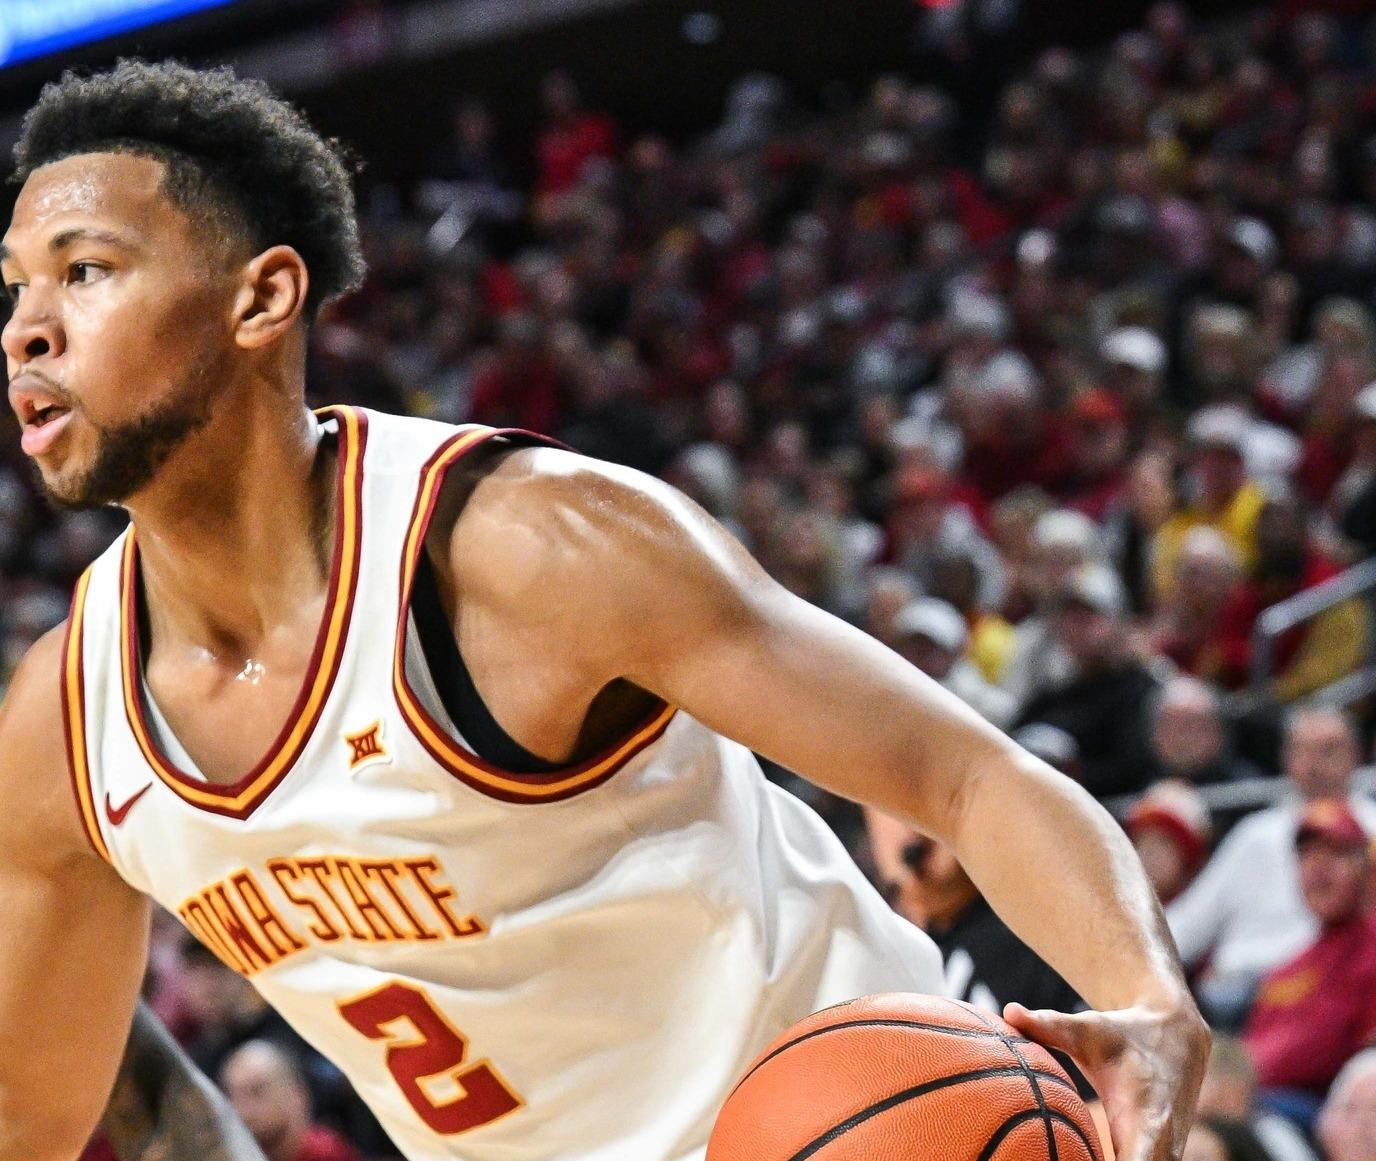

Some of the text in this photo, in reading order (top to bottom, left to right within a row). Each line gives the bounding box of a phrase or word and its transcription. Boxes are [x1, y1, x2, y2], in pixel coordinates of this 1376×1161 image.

[177, 855, 489, 976] OWA STATE
[336, 979, 527, 1137] 2
